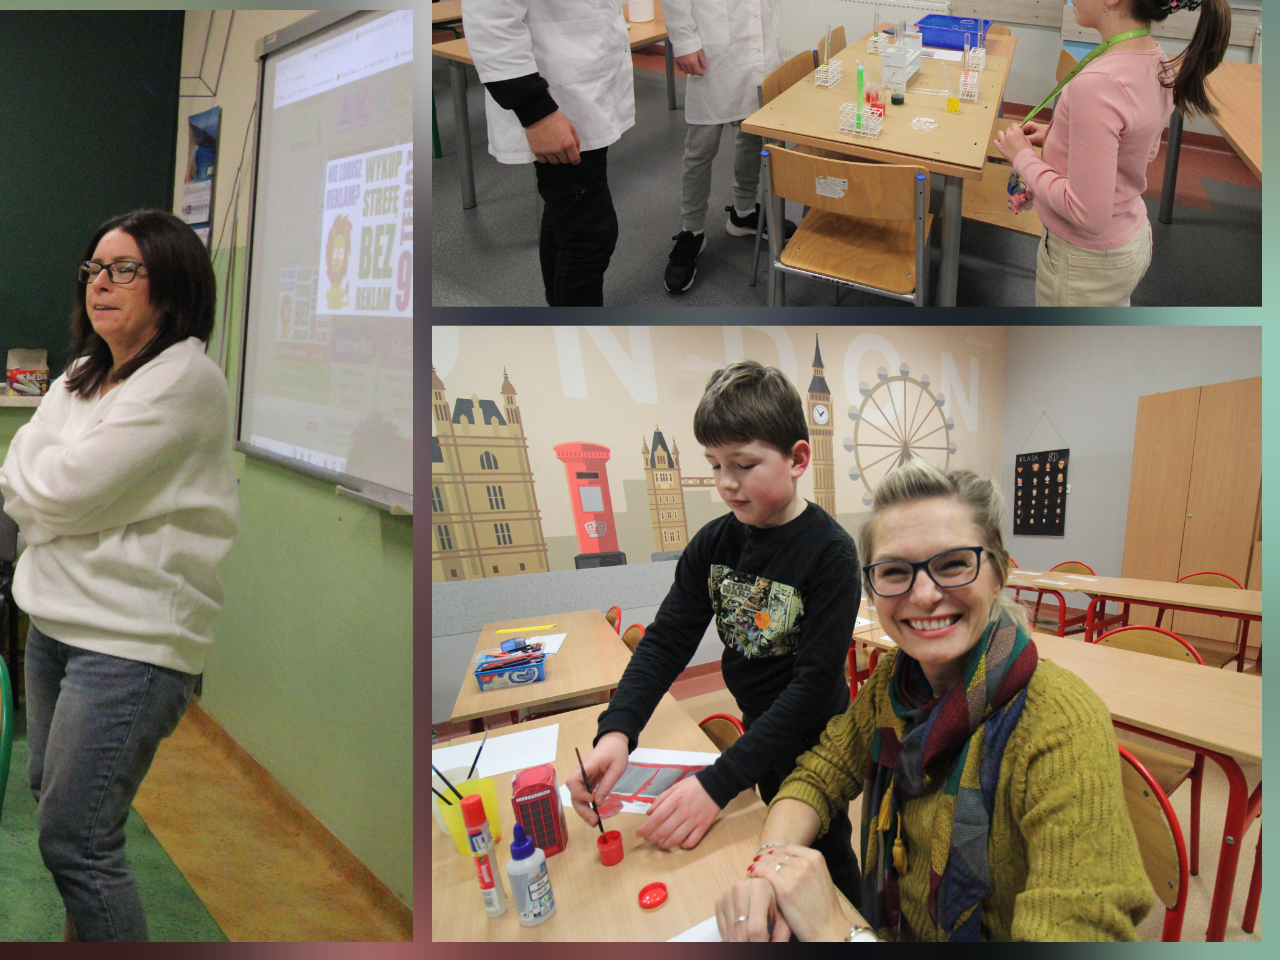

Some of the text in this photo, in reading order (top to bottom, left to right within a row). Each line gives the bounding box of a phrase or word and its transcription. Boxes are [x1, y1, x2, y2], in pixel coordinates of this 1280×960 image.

[365, 150, 403, 183] WYKUP
[362, 185, 400, 218] STREFĘ
[357, 223, 397, 280] BEZ
[355, 286, 392, 312] REKLAM
